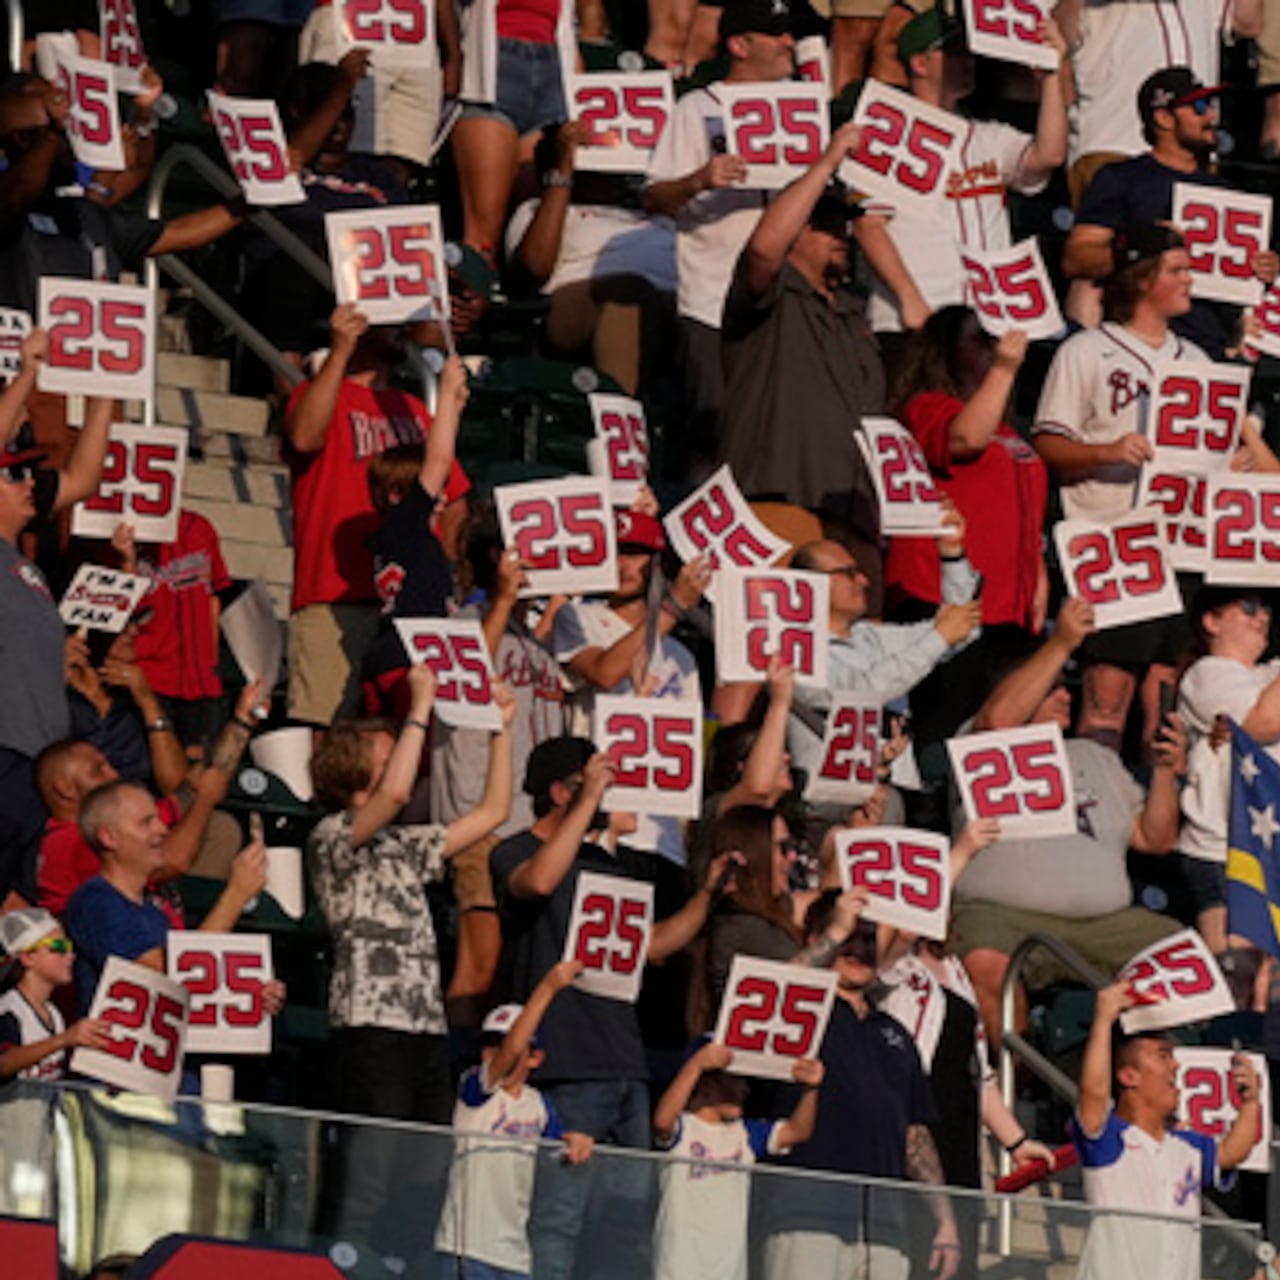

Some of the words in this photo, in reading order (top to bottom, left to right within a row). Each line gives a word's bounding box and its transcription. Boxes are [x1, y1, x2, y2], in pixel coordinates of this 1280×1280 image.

[218, 101, 290, 182] 25
[575, 88, 668, 149] 25
[730, 98, 822, 165] 25
[850, 101, 953, 194] 25
[351, 224, 433, 299] 25
[1182, 203, 1262, 279] 25
[965, 258, 1046, 320] 25
[50, 295, 145, 374] 25
[603, 414, 645, 480] 25
[1158, 376, 1243, 451] 25
[85, 442, 175, 518] 25
[513, 495, 606, 569] 25
[1070, 521, 1166, 604] 25
[745, 577, 814, 675] 25
[413, 636, 494, 705] 25
[607, 713, 693, 790] 25
[820, 707, 878, 782] 25
[964, 740, 1066, 818] 25
[849, 840, 943, 910] 25
[576, 894, 647, 975] 25
[178, 951, 263, 1026] 25
[1126, 941, 1214, 1005] 25
[104, 980, 183, 1073] 25
[725, 978, 825, 1055] 25
